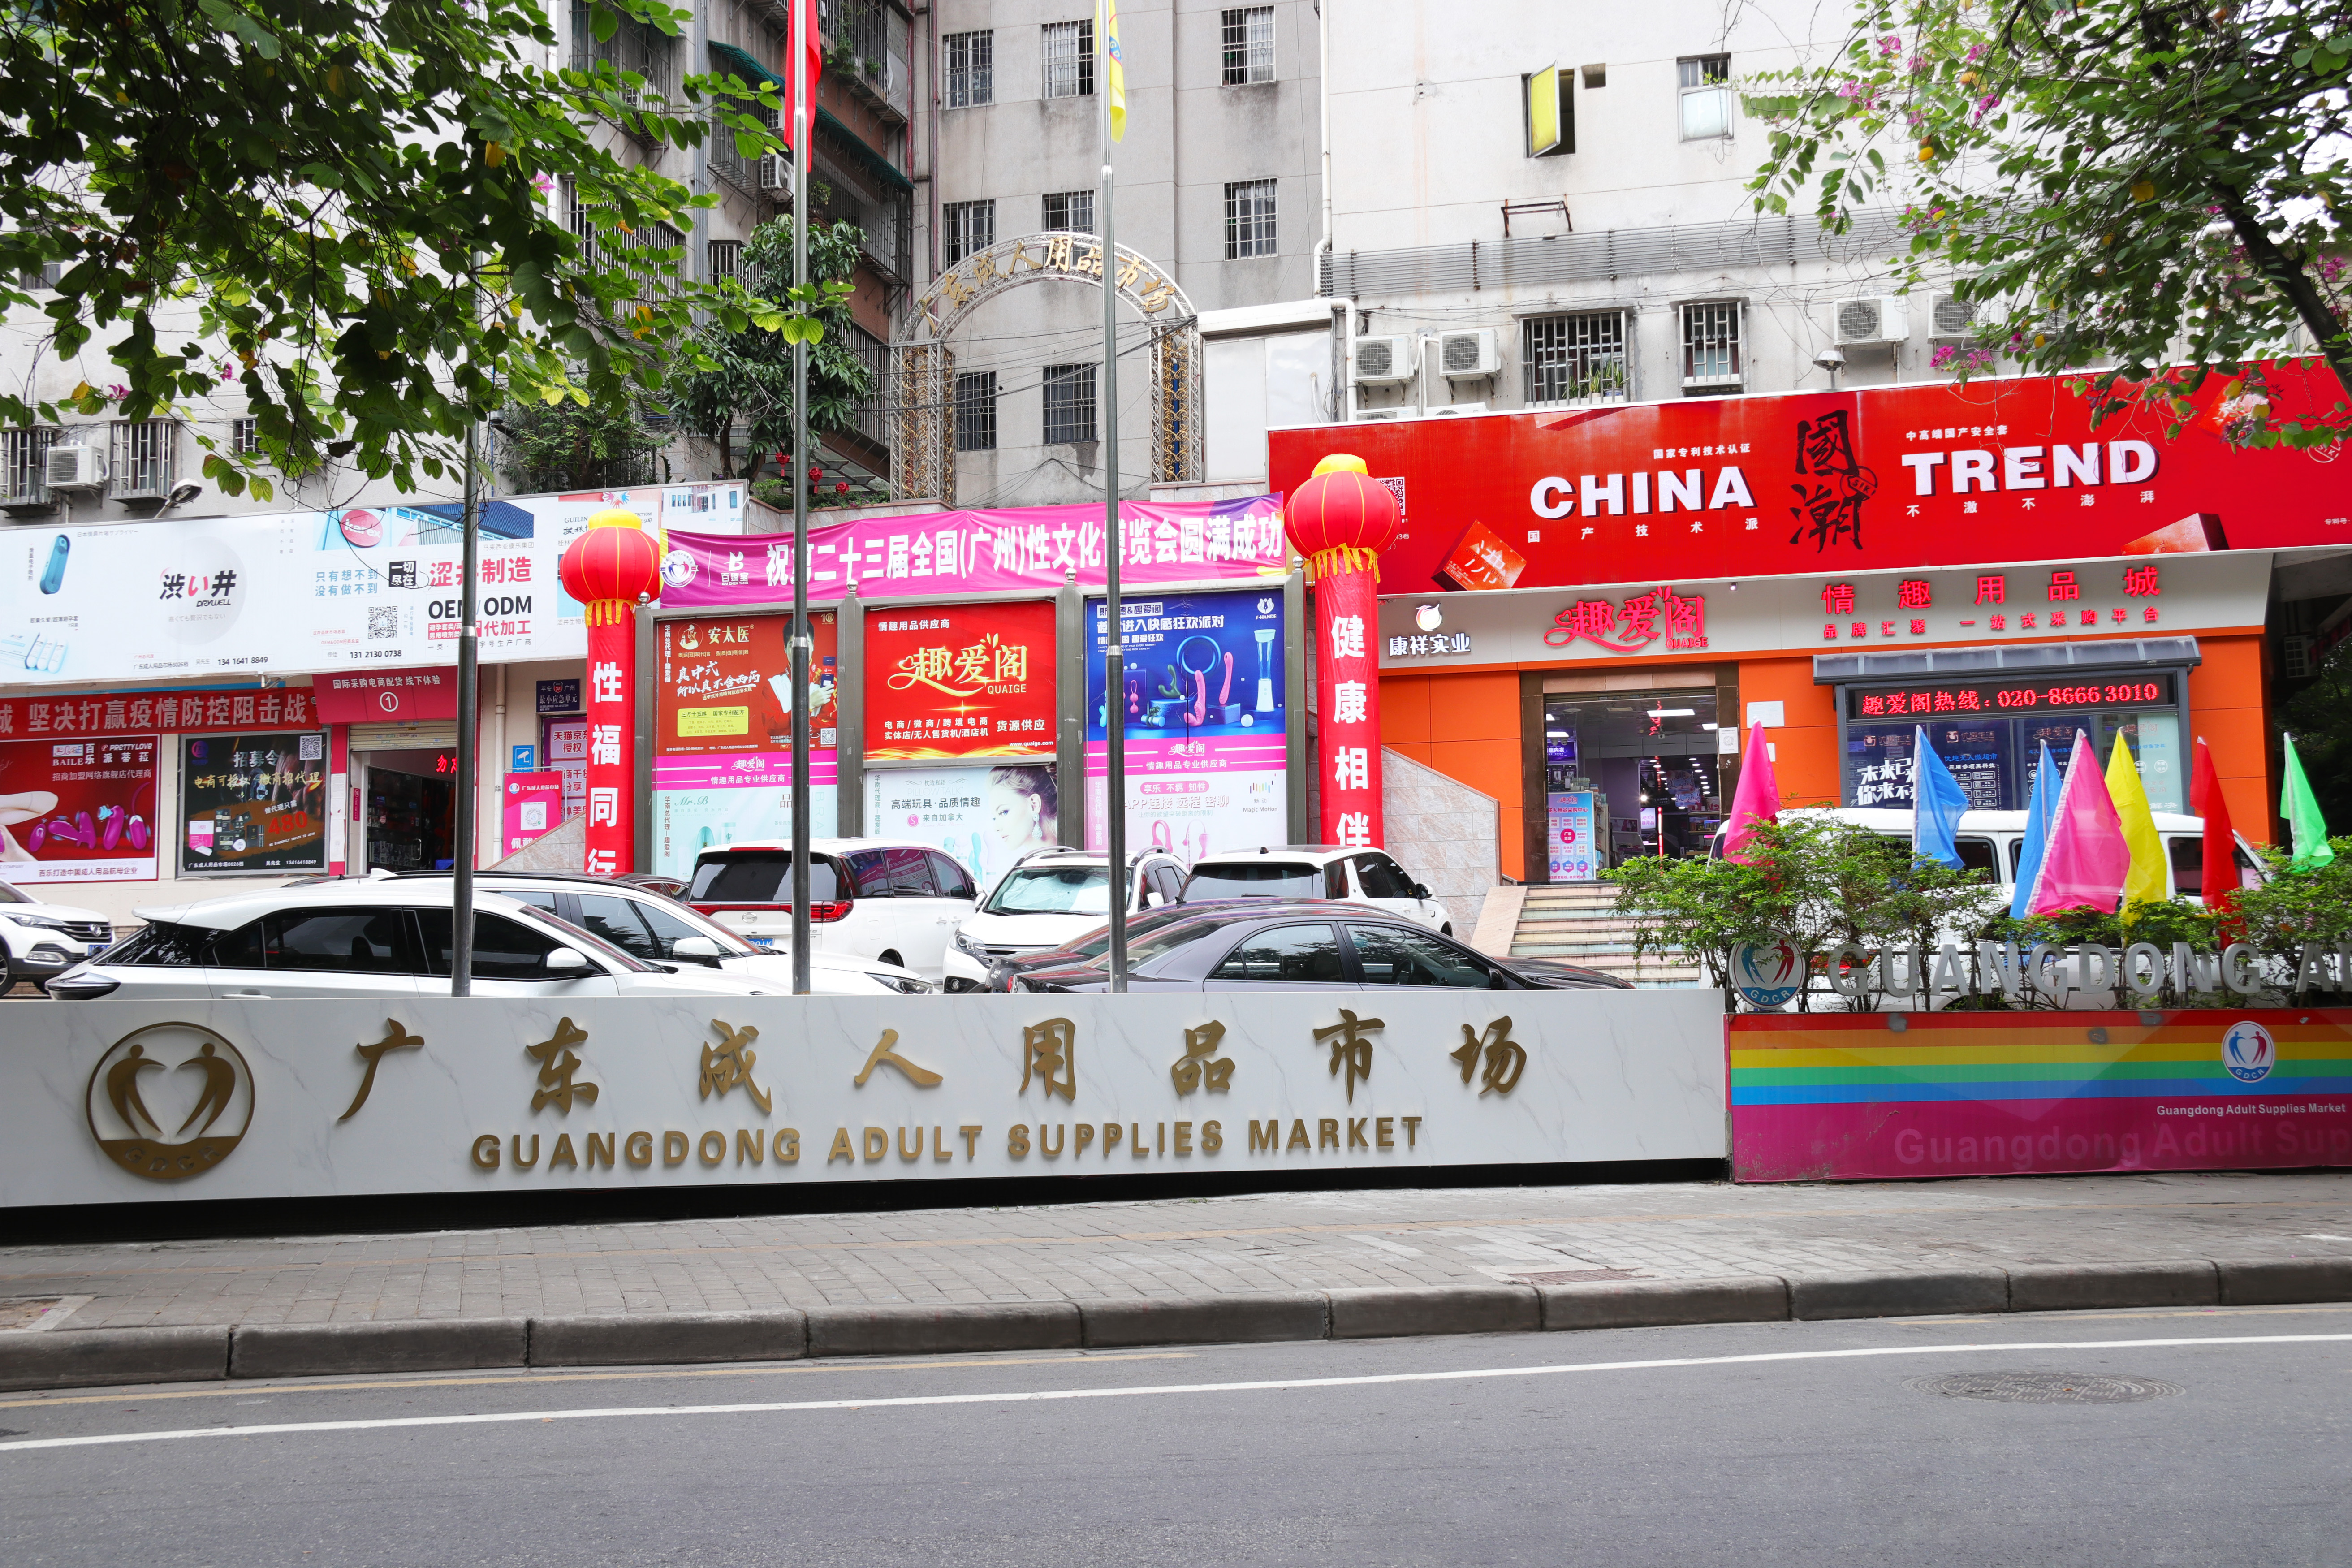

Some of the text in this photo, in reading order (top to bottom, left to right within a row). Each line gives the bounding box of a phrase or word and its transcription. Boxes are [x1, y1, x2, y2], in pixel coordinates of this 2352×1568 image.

[1906, 425, 2007, 441] 中高端国产安全套
[1653, 443, 1750, 459] 国家专利技术认证
[1902, 440, 2156, 496] TREND
[1530, 466, 1755, 518] CHINA
[1907, 491, 2154, 517] 不激不澎湃
[345, 518, 380, 538] karex
[1528, 517, 1758, 542] 国产技术派
[483, 541, 534, 551] 马来西亚康乐集团
[766, 512, 1282, 586] 祝二十三届全国(广州)性文化览会圆满成功
[391, 561, 416, 573] 一切
[315, 568, 378, 583] 只有想不到
[391, 574, 416, 586] 尽在
[160, 570, 237, 600] 渋い井
[315, 583, 378, 597] 没有做不到
[1822, 566, 2160, 614] 情趣用品城
[196, 599, 232, 607] DRYWELL
[484, 596, 532, 616] ODM
[429, 622, 481, 631] 避孕套类/润类
[484, 620, 532, 637] 代加工
[878, 619, 950, 632] 情趣用品供应商
[1097, 614, 1225, 635] 邀进入快感狂欢派对
[1544, 590, 1706, 653] 趣爱阁
[1823, 606, 2159, 639] 品牌汇聚 一站式采购平台
[708, 626, 749, 644] 安太医
[1131, 633, 1164, 644] 趣爱狂欢
[1389, 632, 1471, 656] 康祥实业
[1666, 637, 1709, 649] QUAIGE
[218, 656, 268, 666] 134 1641 8849
[350, 650, 402, 661] 131 2130 0738
[888, 632, 1028, 697] 趣爱阁
[333, 675, 441, 690] 国际采购电商配货 线下体验
[987, 683, 1027, 695] QUAIGE
[539, 694, 577, 704] 最小应急单元
[28, 695, 306, 732] 坚决打赢疫情防控阻击战
[996, 718, 1046, 733] 货源供应
[1331, 614, 1371, 847] 健康相伴
[563, 743, 583, 753] 授权
[1167, 740, 1205, 757] 趣爱阁
[52, 758, 84, 766] BAILE
[233, 749, 280, 767] 招募令
[731, 756, 765, 772] 趣爱阁
[1146, 759, 1227, 771] 情趣用品专业供应商
[555, 769, 587, 780] 商干货
[587, 661, 623, 873] 性福同行
[52, 769, 152, 781] 招商加盟网络旗舰店代理商
[711, 774, 785, 785] 情趣用品专业供应商
[522, 784, 560, 792] 广东成人用品市场
[907, 786, 961, 796] PILLOW TALK
[1143, 782, 1207, 793] 享乐 不羁 知性
[1176, 796, 1201, 808] 远程
[923, 813, 963, 822] 来自加拿大
[1138, 809, 1213, 818] 让你的欲望突破距离的限制
[269, 811, 308, 835] 480
[1828, 942, 2262, 997] GUANGDONG
[1750, 989, 1791, 1003] GDCR
[338, 1008, 1528, 1121] 广东成人用品市场
[2235, 1067, 2265, 1079] GDCR
[2157, 1103, 2346, 1117] Guangdong Adult Supplies Market
[472, 1116, 1423, 1171] GUANGDONG ADULT SUPPLIES MARKET
[1894, 1125, 2142, 1167] Guangdong
[2153, 1122, 2265, 1158] Adult
[125, 1145, 221, 1172] GDCR
